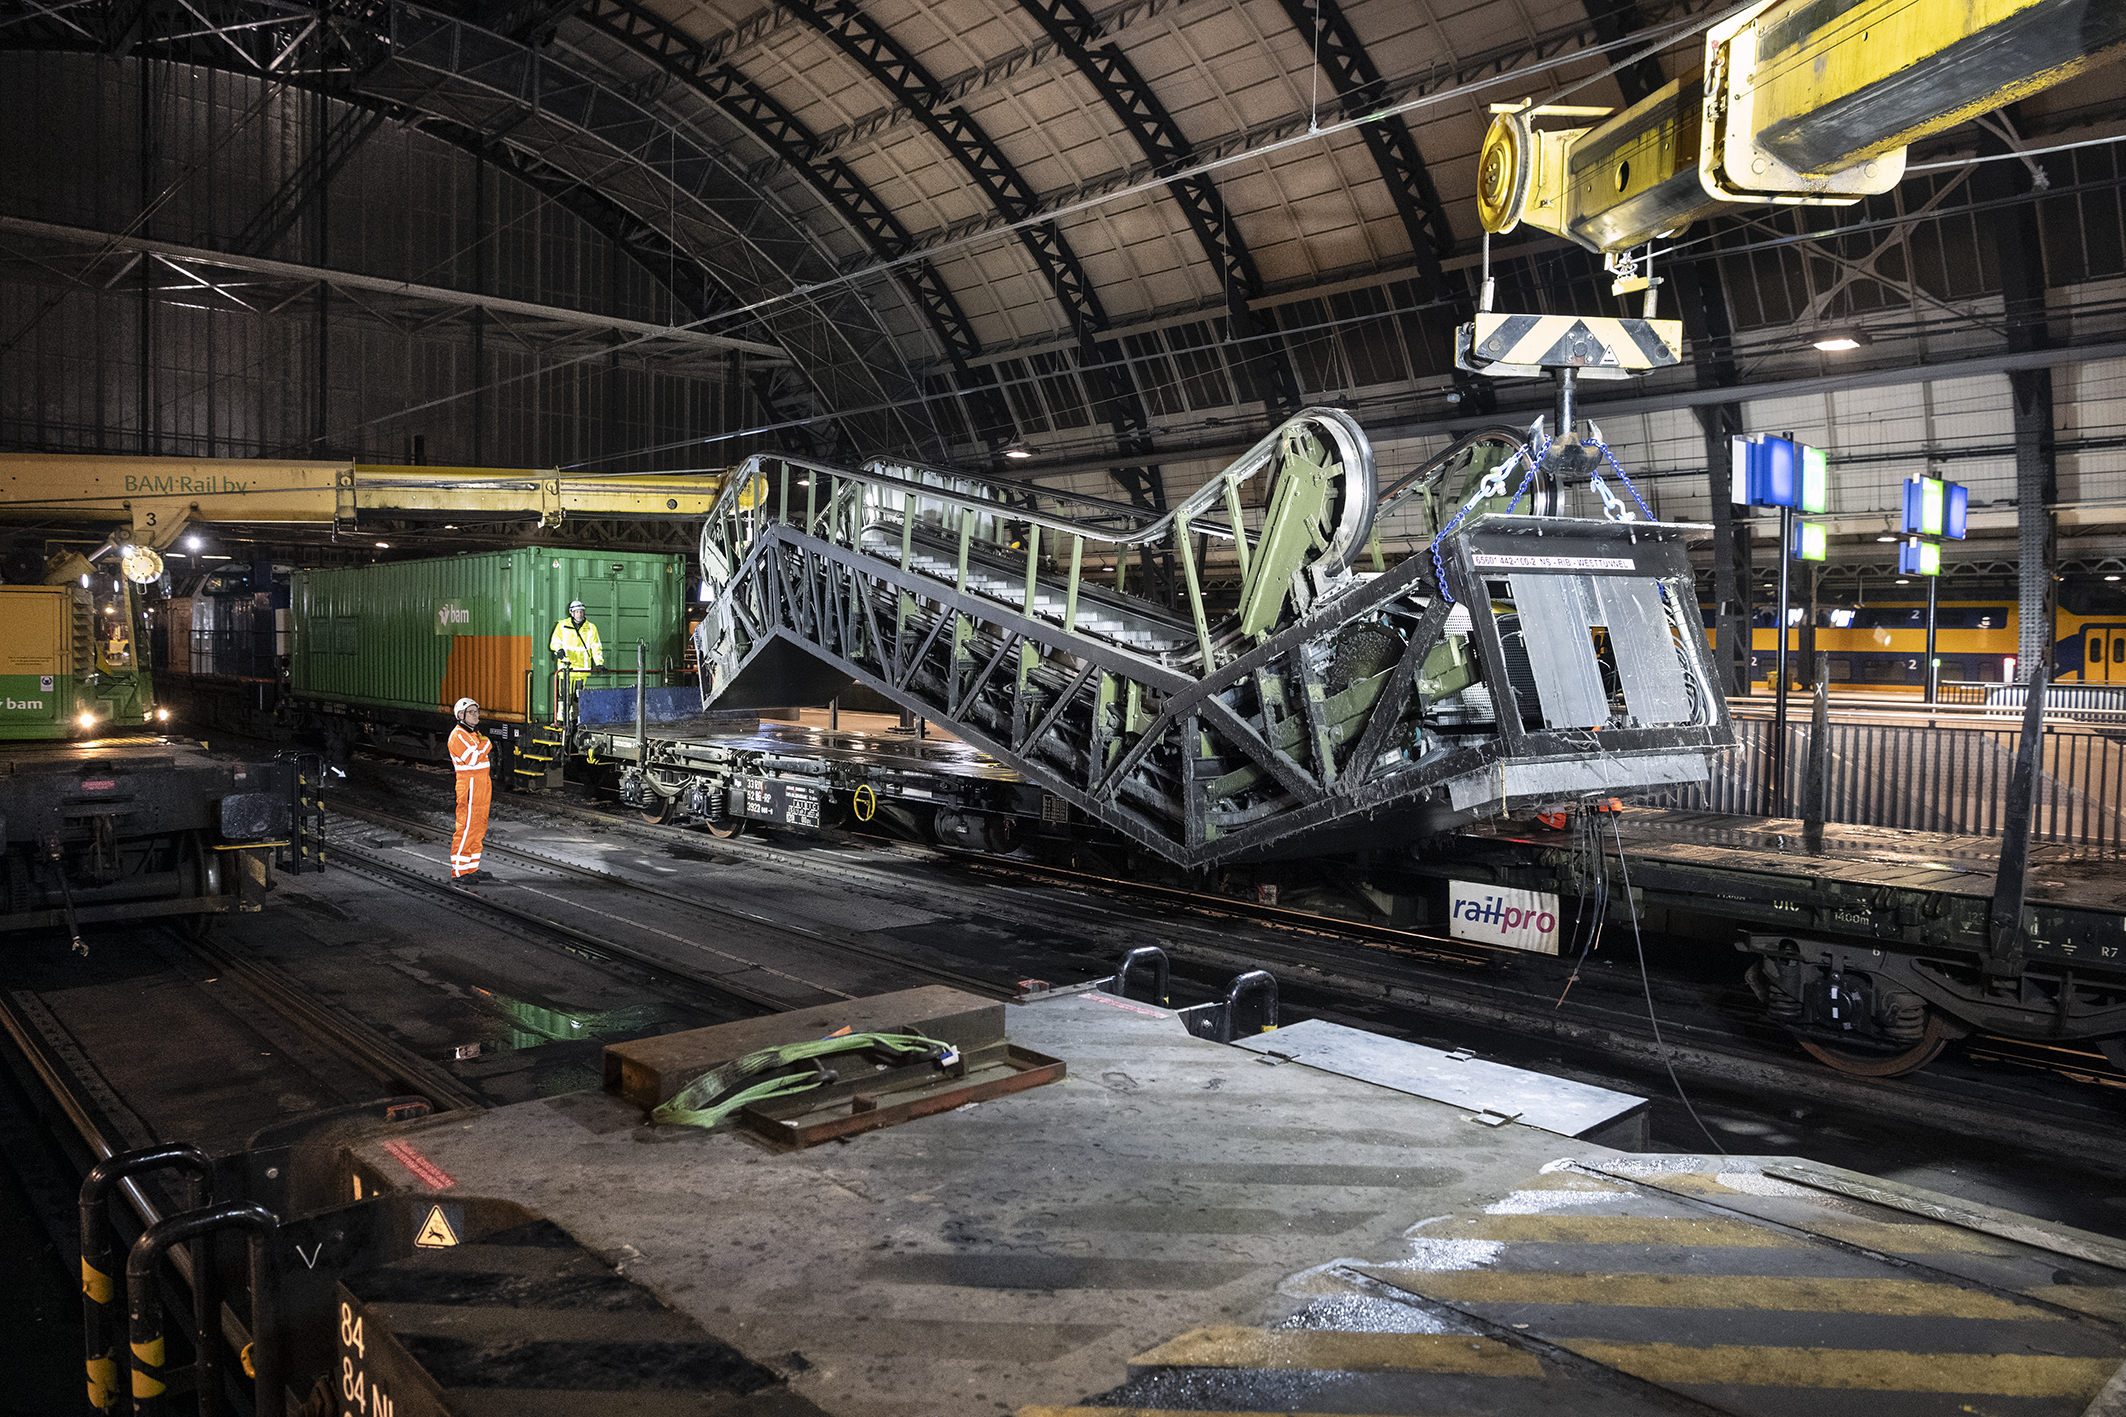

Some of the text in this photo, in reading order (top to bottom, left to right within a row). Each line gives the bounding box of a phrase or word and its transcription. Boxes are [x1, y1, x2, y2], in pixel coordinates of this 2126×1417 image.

[125, 475, 173, 492] BAM
[180, 476, 217, 494] Rail
[146, 512, 157, 526] 3
[1577, 559, 1629, 568] WESTTUNNEL
[451, 604, 469, 623] bam
[1911, 610, 1920, 620] 2
[1751, 657, 1758, 667] 2
[1908, 659, 1917, 670] 2
[6, 697, 43, 710] bam
[747, 779, 754, 789] 33
[747, 791, 755, 800] 52
[1453, 896, 1556, 934] railpro
[2101, 946, 2119, 958] R7
[342, 1302, 365, 1359] 84
[343, 1356, 367, 1414] 84
